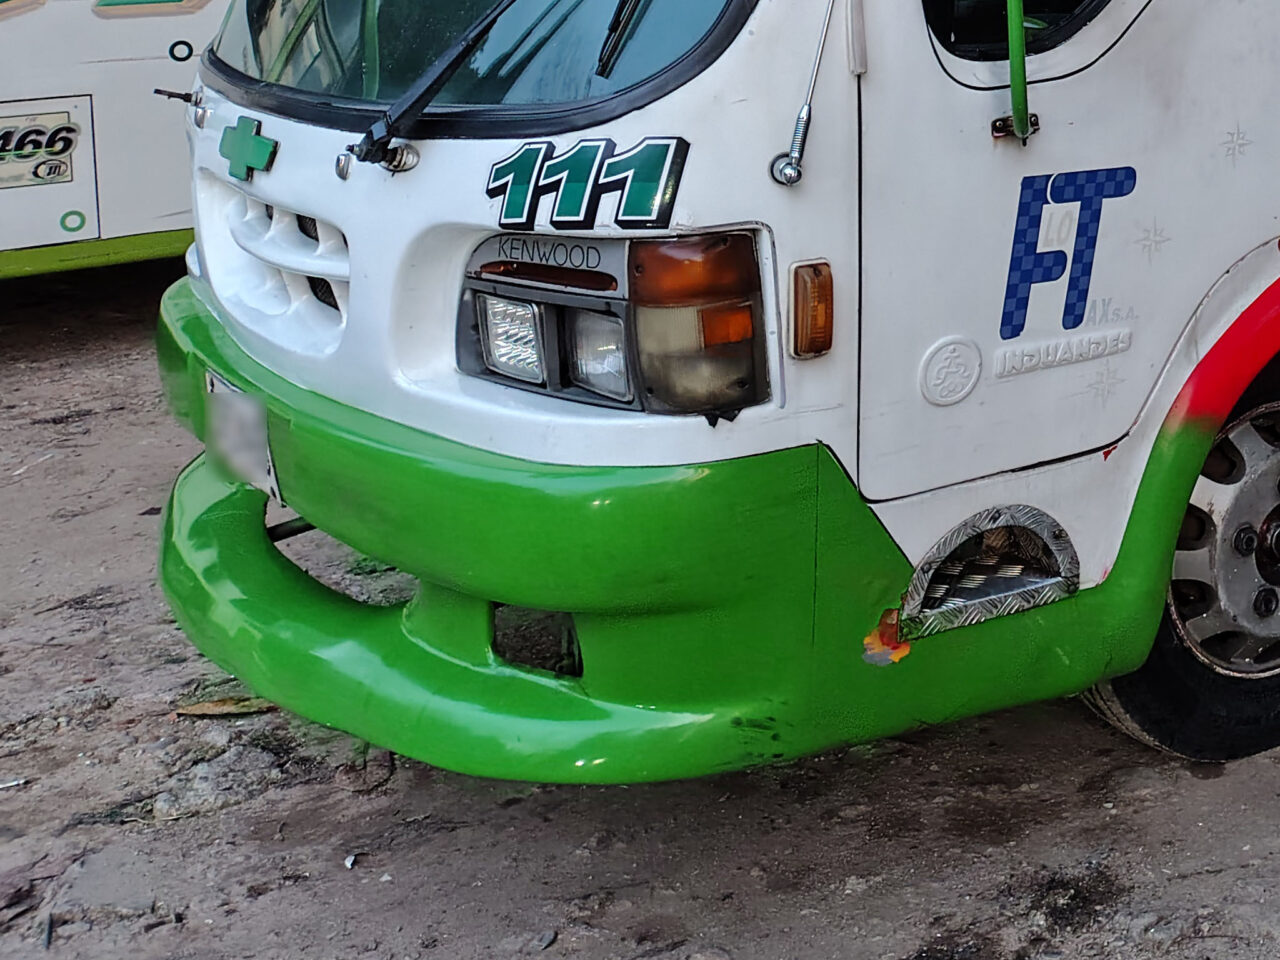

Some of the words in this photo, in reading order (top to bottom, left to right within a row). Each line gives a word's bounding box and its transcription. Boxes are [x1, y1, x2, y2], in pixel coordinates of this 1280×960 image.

[486, 136, 691, 231] 111
[498, 238, 601, 269] KENWOOD
[995, 329, 1132, 377] INDUANDES
